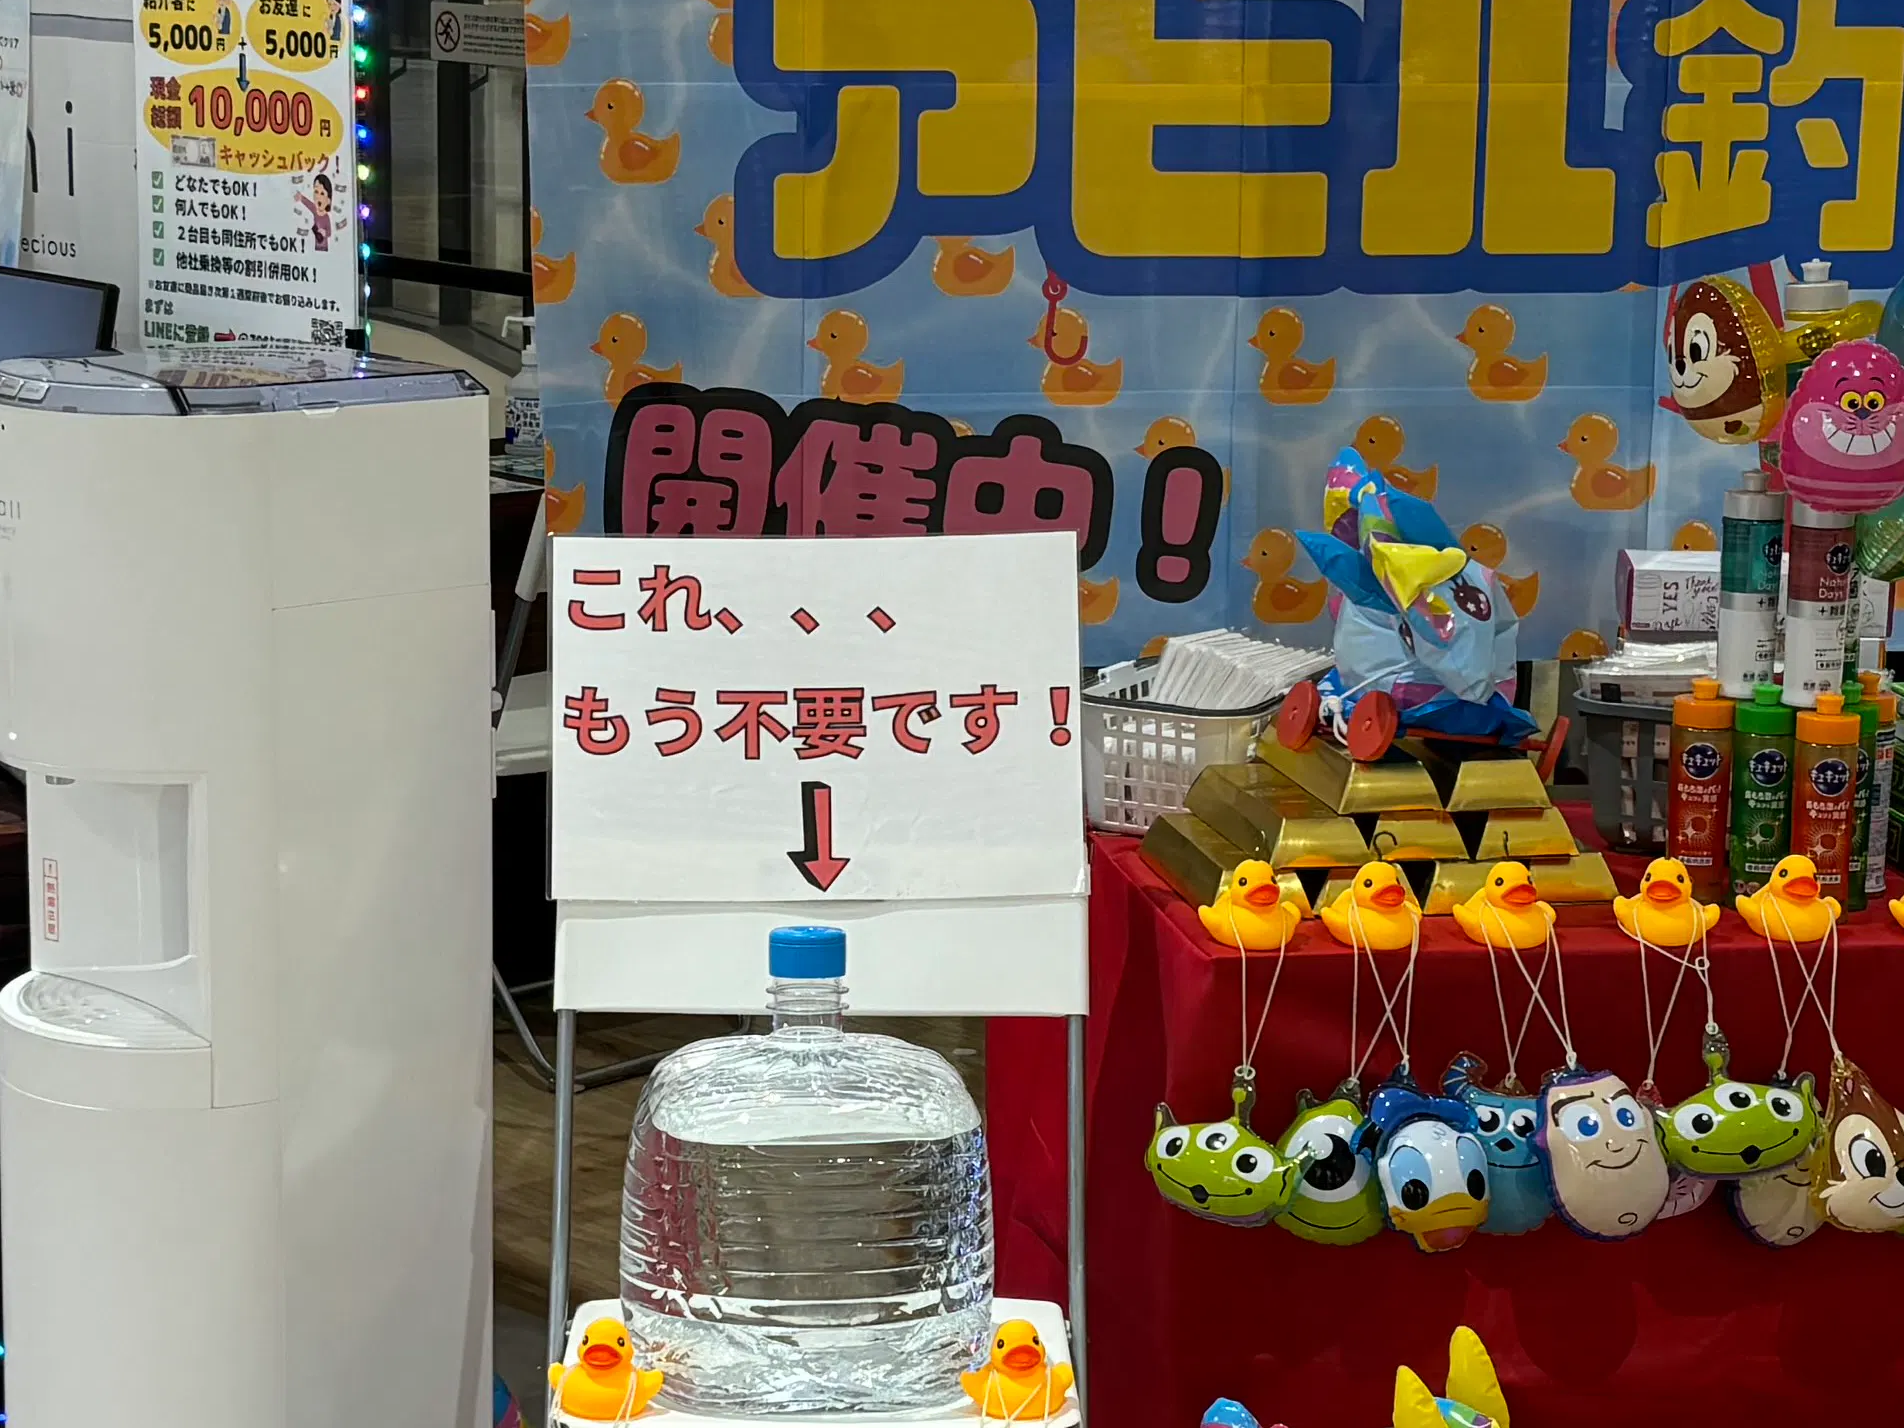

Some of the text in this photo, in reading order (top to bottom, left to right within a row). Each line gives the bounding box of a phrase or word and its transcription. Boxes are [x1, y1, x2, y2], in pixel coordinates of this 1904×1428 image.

[20, 233, 77, 257] ecious
[563, 685, 1073, 760] もう不要です！
